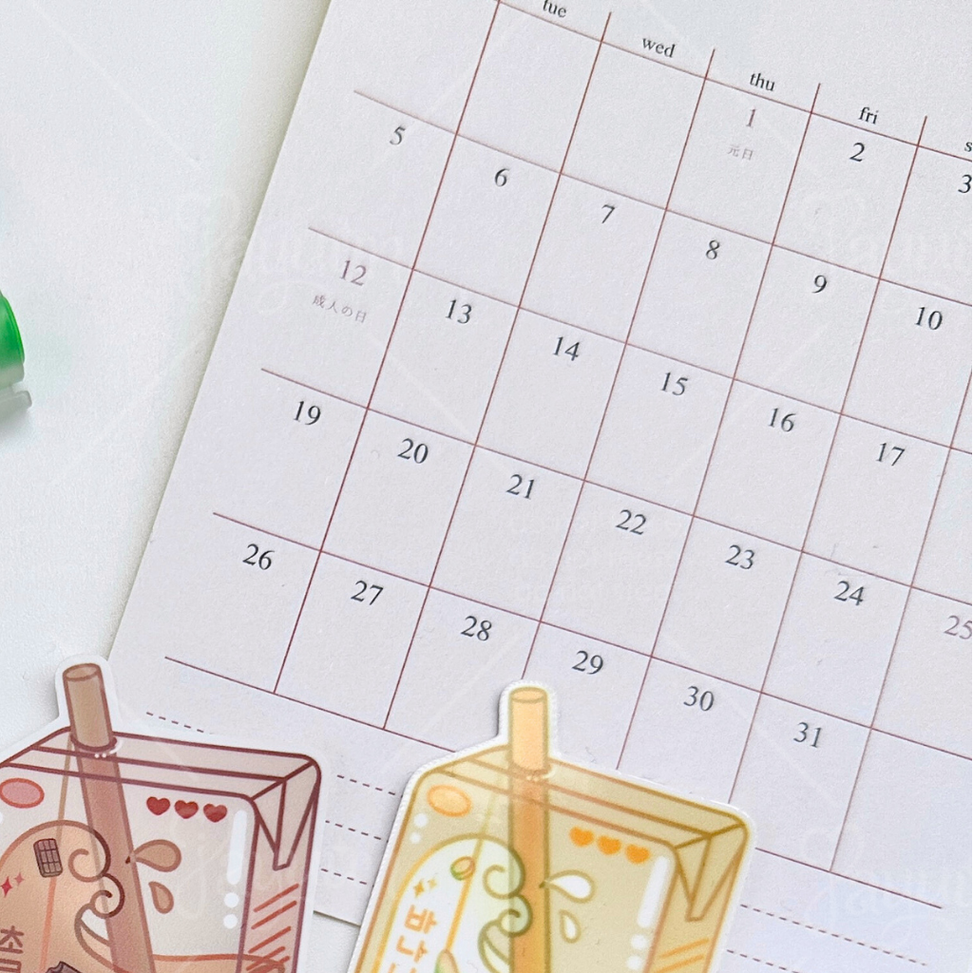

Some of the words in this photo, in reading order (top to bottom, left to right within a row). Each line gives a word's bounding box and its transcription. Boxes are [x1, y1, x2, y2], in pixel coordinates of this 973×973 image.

[542, 0, 568, 19] tue
[641, 36, 676, 59] wed
[748, 72, 776, 93] thu
[858, 106, 879, 125] fri
[745, 107, 758, 129] 1
[848, 141, 866, 163] 2
[957, 173, 973, 195] 3
[311, 294, 368, 324] 成人の日
[388, 124, 407, 146] 5
[493, 166, 511, 188] 6
[601, 202, 617, 225] 7
[704, 238, 722, 261] 8
[811, 273, 830, 294] 9
[914, 305, 944, 331] 10
[339, 257, 368, 287] 12
[445, 297, 473, 325] 13
[552, 335, 582, 362] 14
[660, 371, 690, 397] 15
[768, 406, 798, 433] 16
[875, 441, 907, 467] 17
[292, 399, 323, 427] 19
[396, 436, 430, 465] 20
[505, 473, 536, 500] 21
[614, 508, 648, 536] 22
[724, 543, 757, 571] 23
[833, 579, 867, 607] 24
[943, 614, 973, 641] 25
[241, 542, 276, 571] 26
[349, 578, 385, 607] 27
[459, 614, 494, 642] 28
[571, 649, 605, 676] 29
[682, 684, 716, 713] 30
[792, 721, 823, 749] 31
